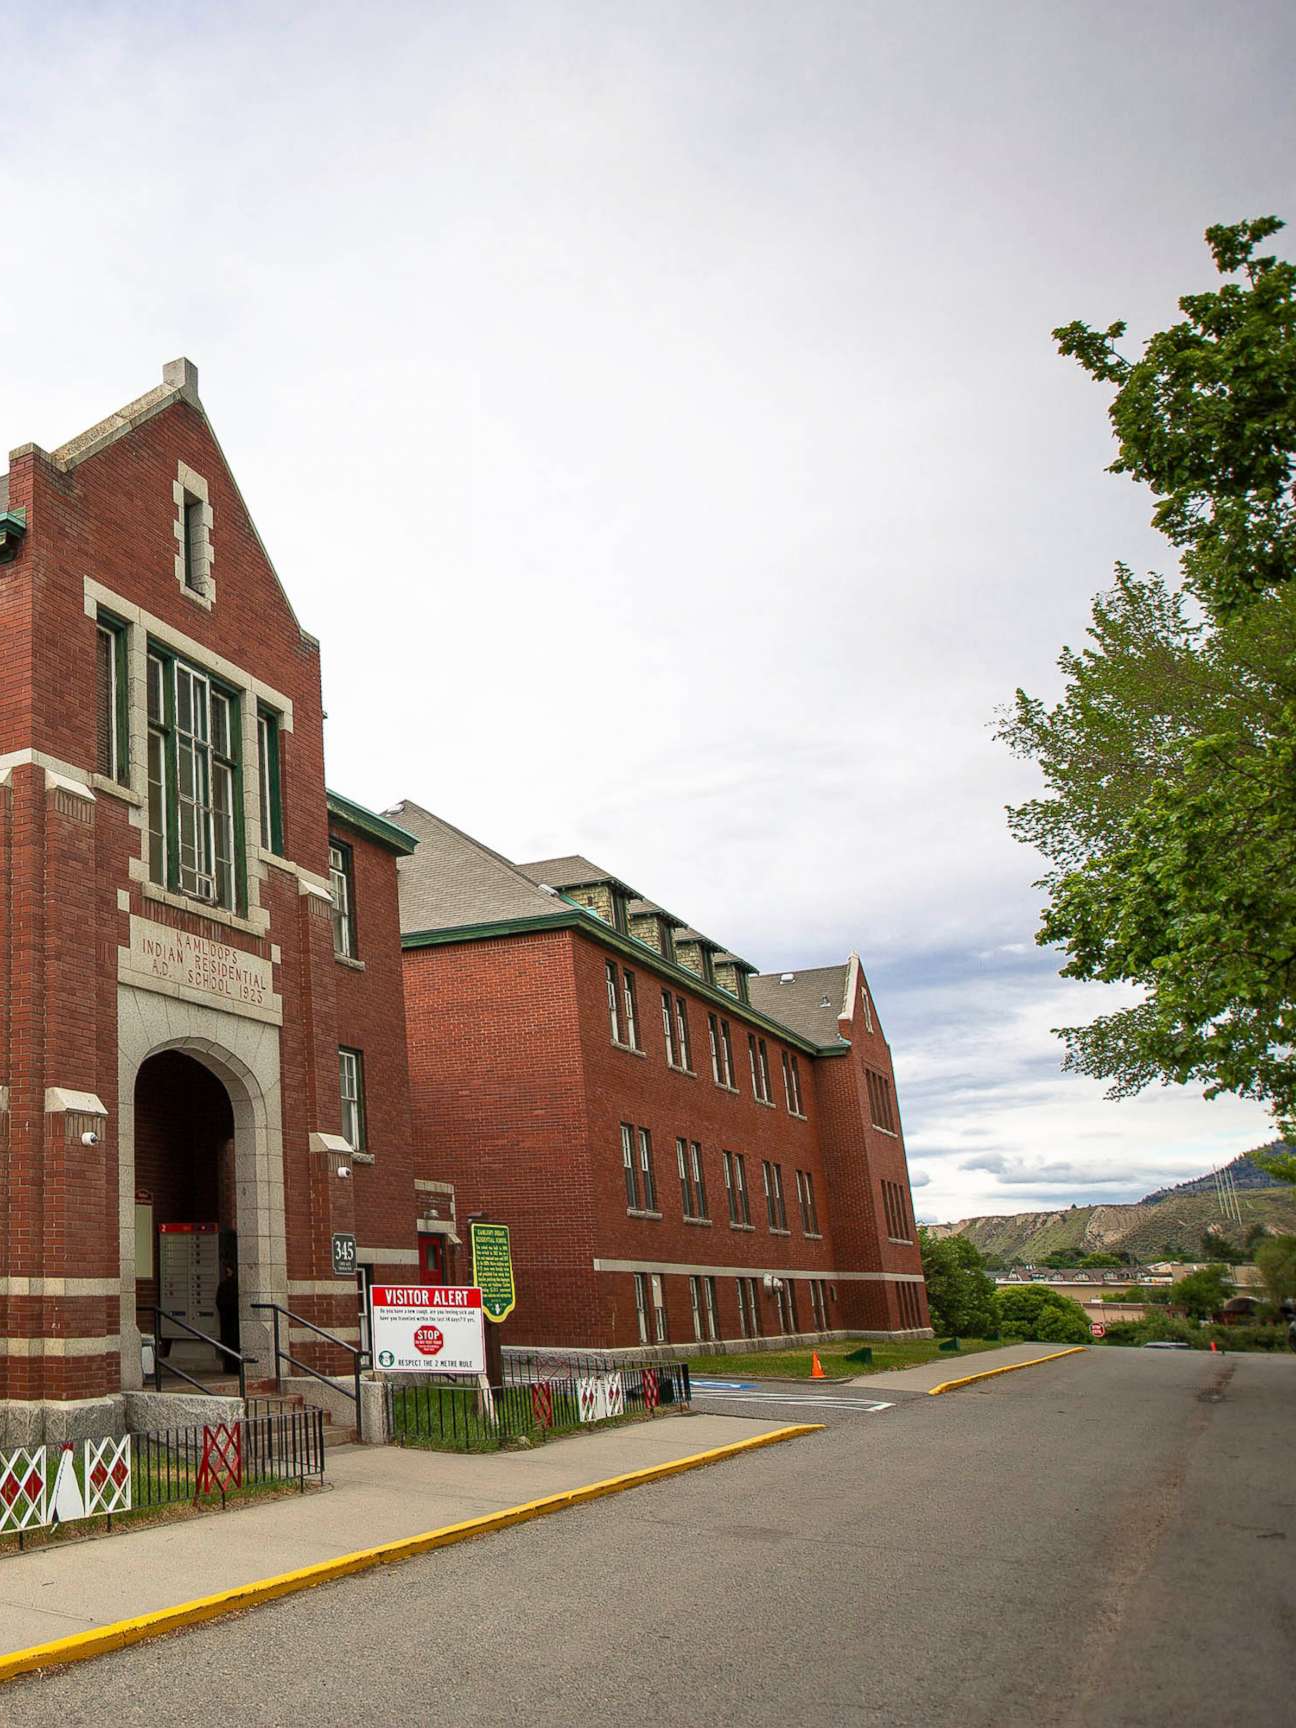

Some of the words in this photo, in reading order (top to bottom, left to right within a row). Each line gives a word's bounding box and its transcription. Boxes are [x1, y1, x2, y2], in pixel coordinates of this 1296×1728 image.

[176, 931, 238, 965] KAMLOOPS
[142, 938, 184, 965] INDIAN
[194, 954, 266, 990] RESIDENTIAL
[151, 959, 172, 978] A.D.
[187, 968, 232, 995] SCHOOL
[335, 1240, 354, 1260] 345
[385, 1289, 429, 1304] VISITOR
[433, 1290, 469, 1305] ALERT
[417, 1330, 440, 1340] STOP
[398, 1359, 421, 1367] RESPECT
[434, 1360, 439, 1368] 2
[440, 1360, 457, 1368] METRE
[459, 1360, 473, 1368] RULE
